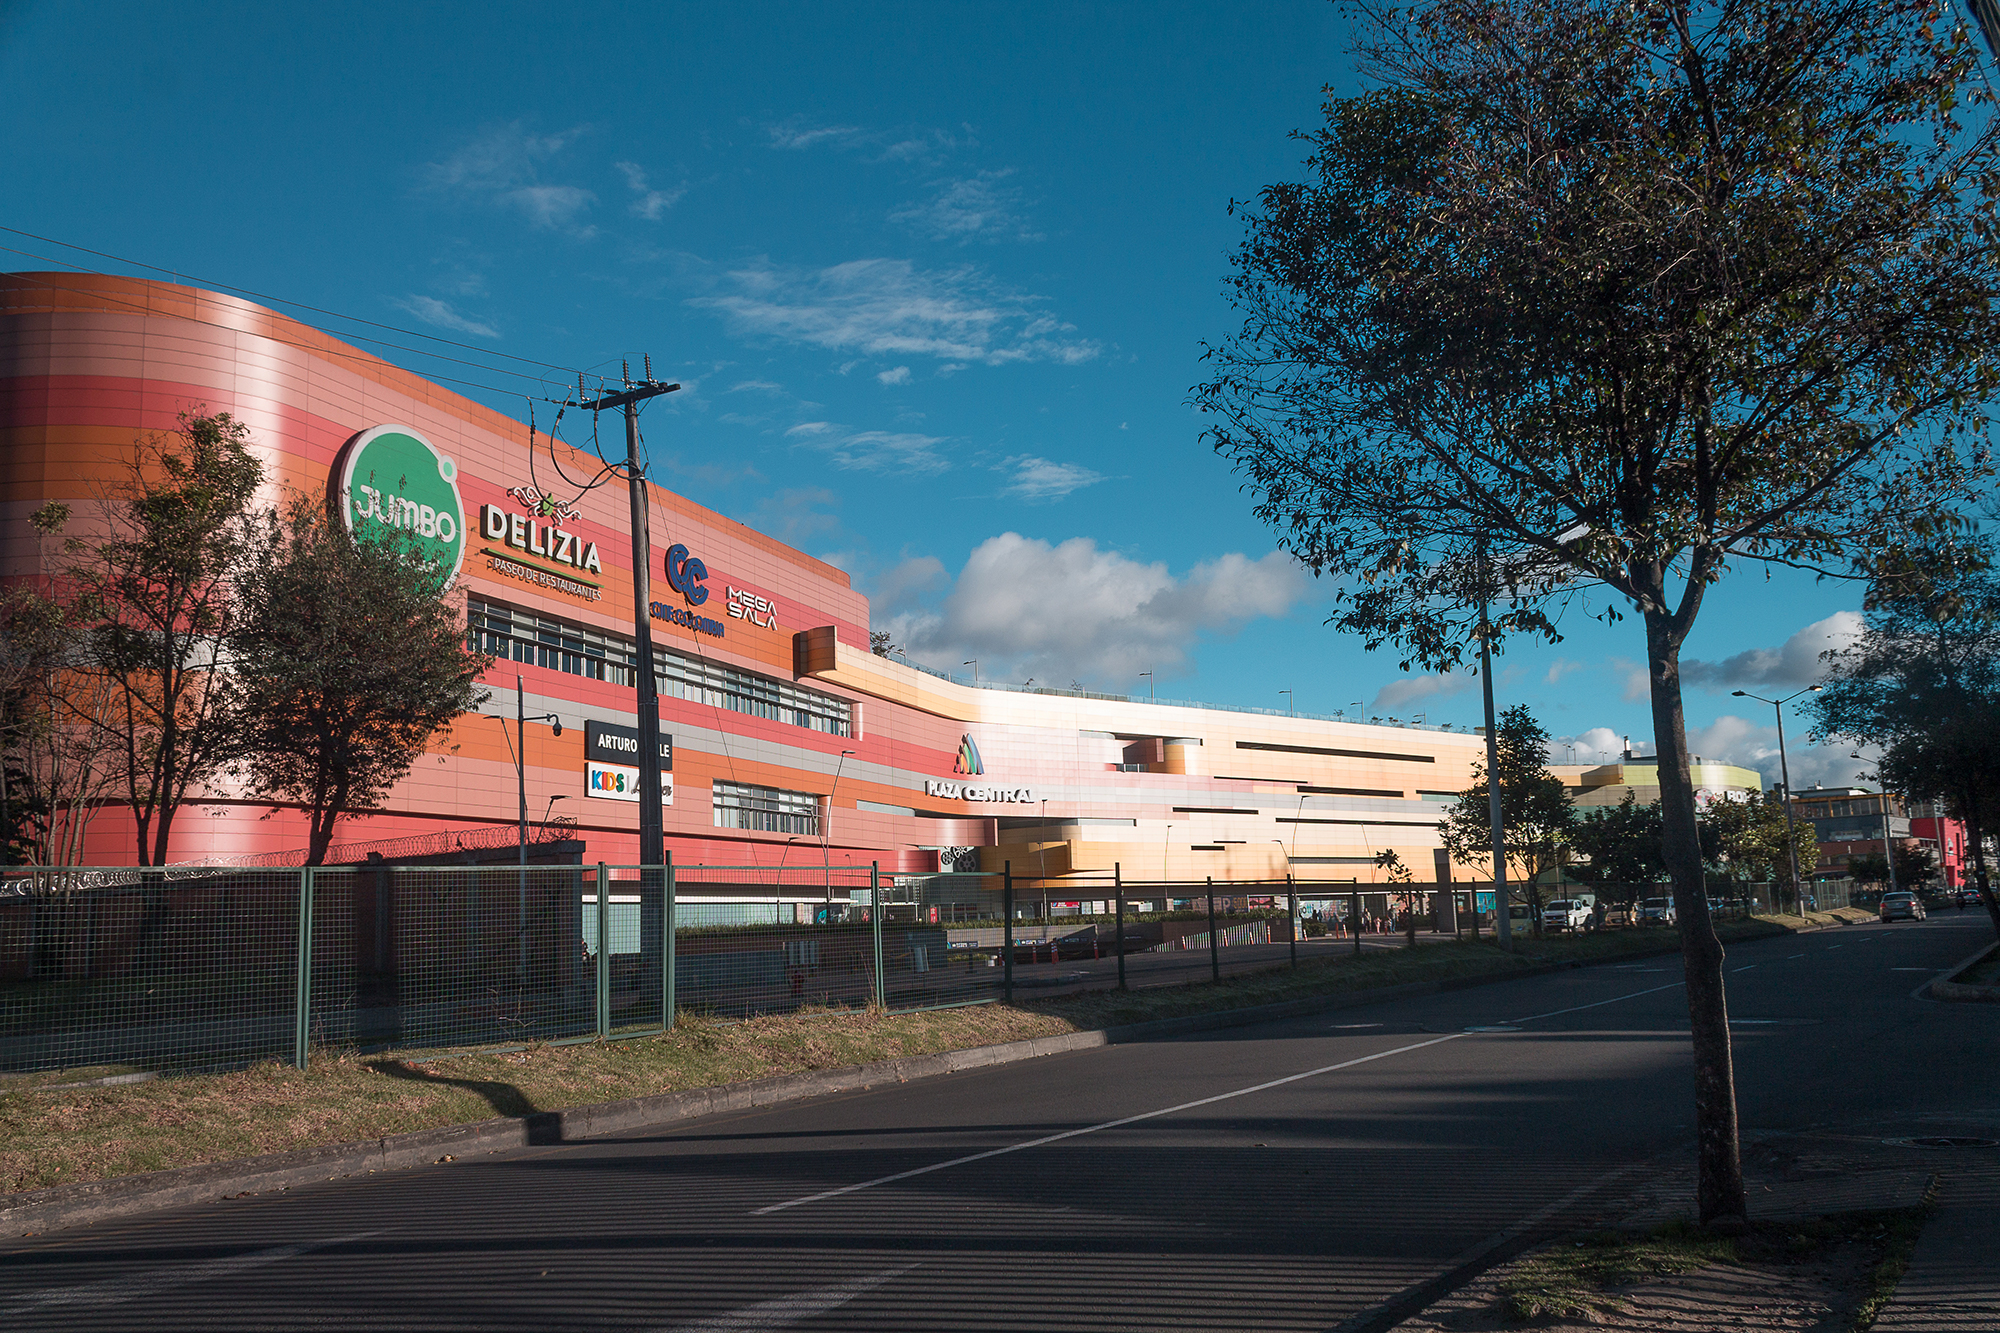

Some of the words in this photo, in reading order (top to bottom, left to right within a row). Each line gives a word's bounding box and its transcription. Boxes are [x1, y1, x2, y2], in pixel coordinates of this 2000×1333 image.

[484, 503, 602, 573] DELIZIA
[494, 557, 525, 578] PASEO
[526, 569, 538, 582] DE
[539, 573, 602, 601] RESTAURANTES
[728, 585, 777, 616] MEGA
[728, 600, 777, 631] SALA
[651, 601, 674, 622] CINE
[675, 608, 725, 638] COLOMBIA
[598, 733, 638, 753] ARTURO
[592, 770, 625, 793] KIDS
[926, 780, 962, 800] PLAZA
[963, 786, 1035, 804] CENTRAL
